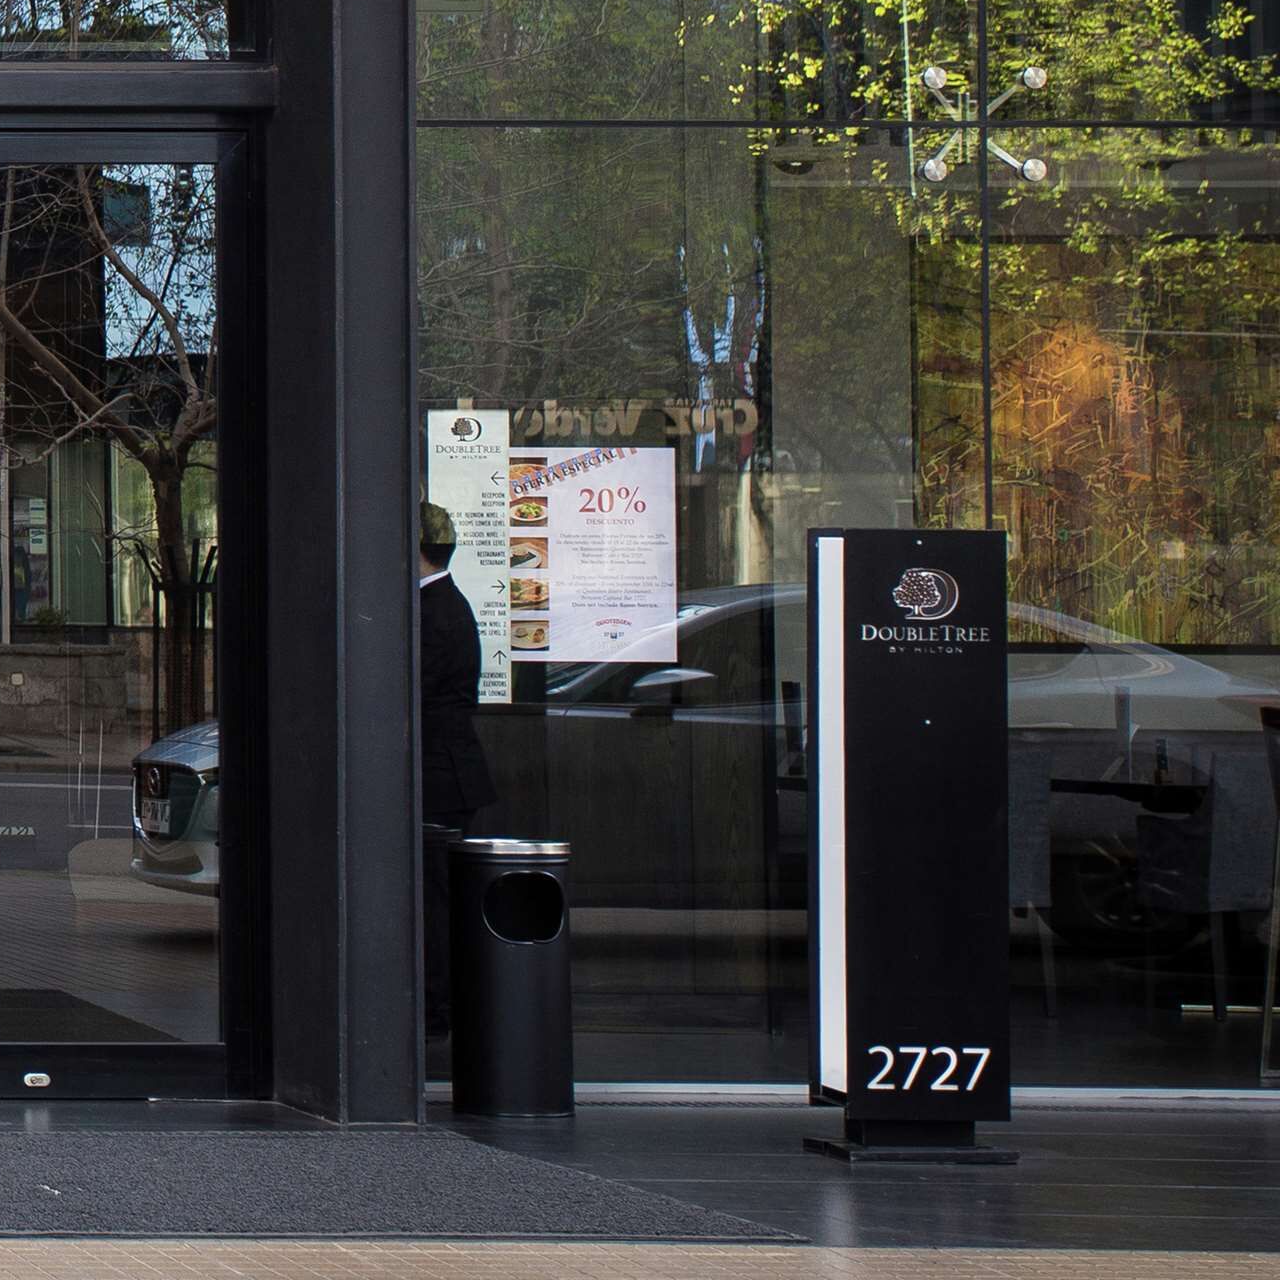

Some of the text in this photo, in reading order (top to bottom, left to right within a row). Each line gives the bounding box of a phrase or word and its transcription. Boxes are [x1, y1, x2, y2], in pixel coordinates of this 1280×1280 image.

[436, 445, 501, 454] DOUBLETREE
[513, 451, 617, 495] OFERTA ESPECIAL
[579, 486, 646, 513] 20%
[861, 624, 991, 642] DOUBLETREE
[914, 646, 964, 654] HILTON
[866, 1045, 992, 1091] 2727
